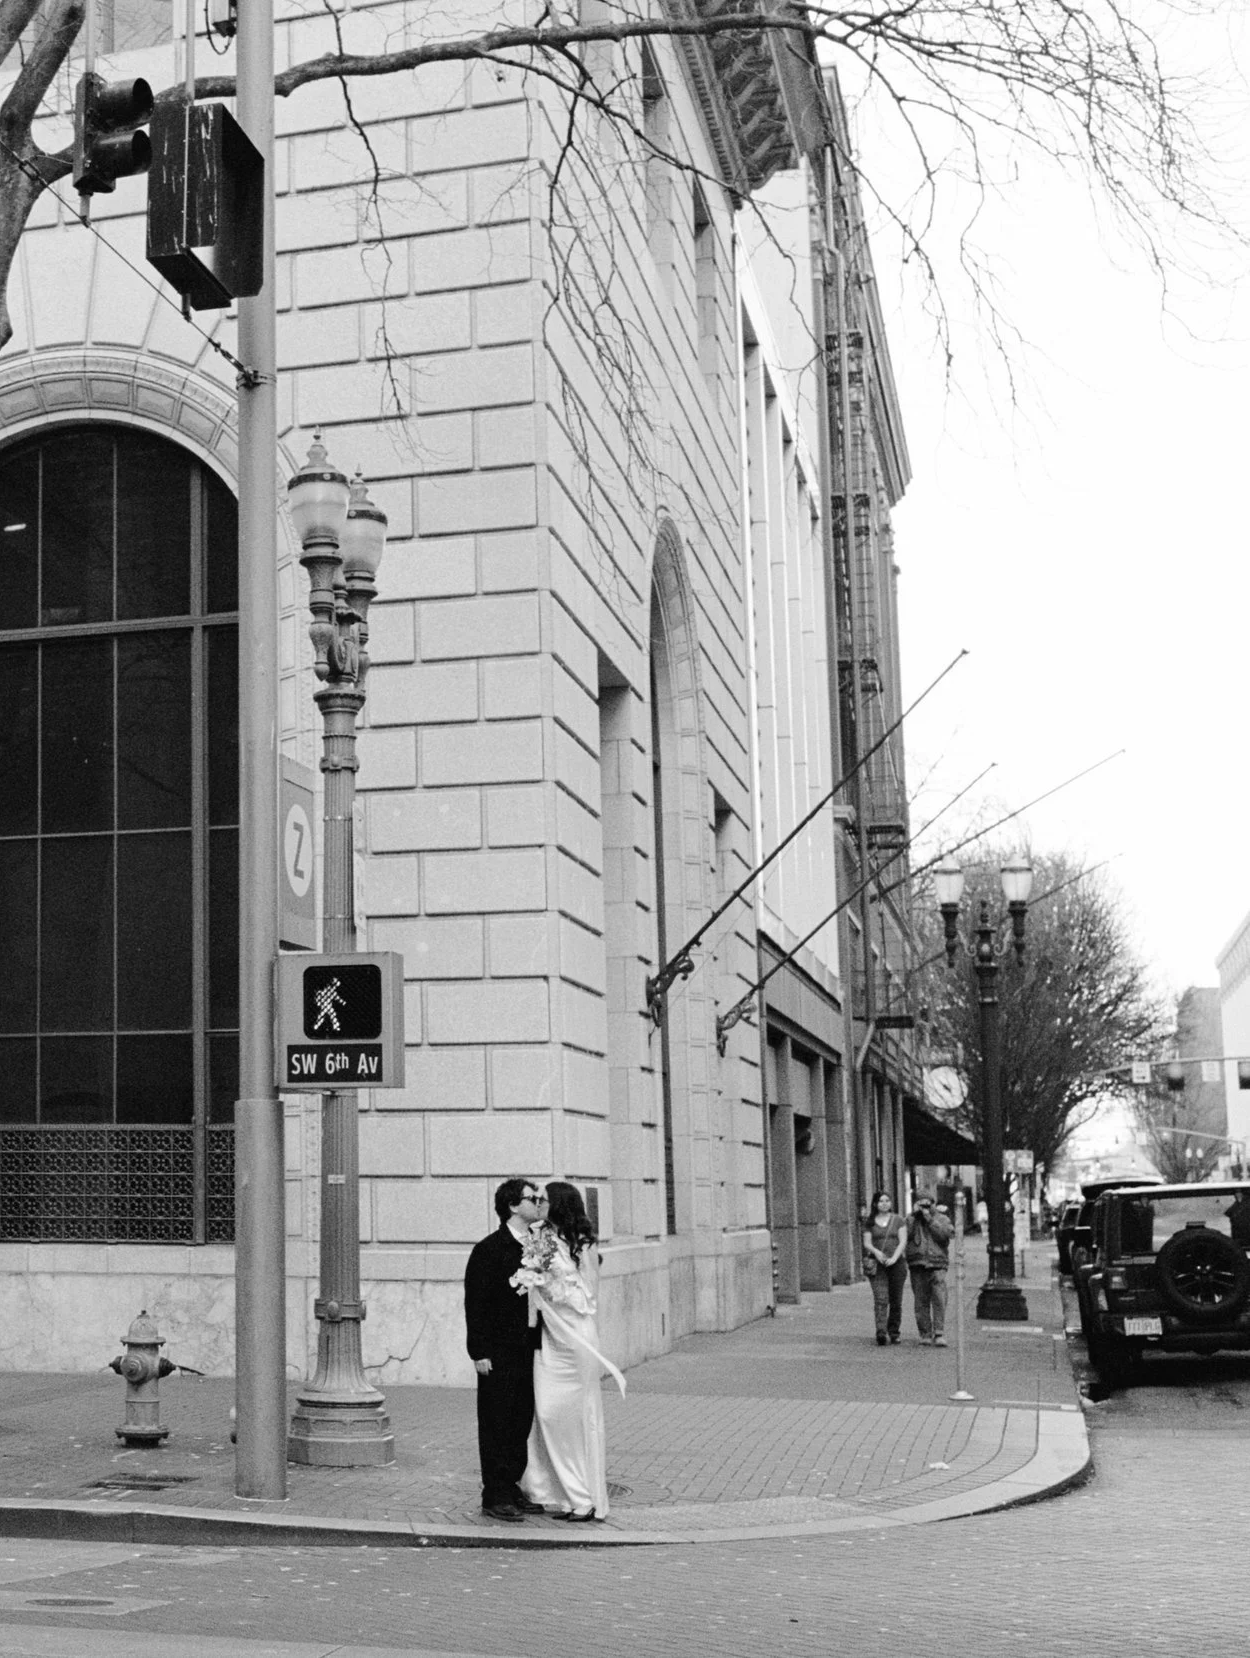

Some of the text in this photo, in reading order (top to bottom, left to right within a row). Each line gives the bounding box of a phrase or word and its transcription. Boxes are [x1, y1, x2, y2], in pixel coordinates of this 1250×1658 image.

[291, 1052, 379, 1075] SW 6th Av
